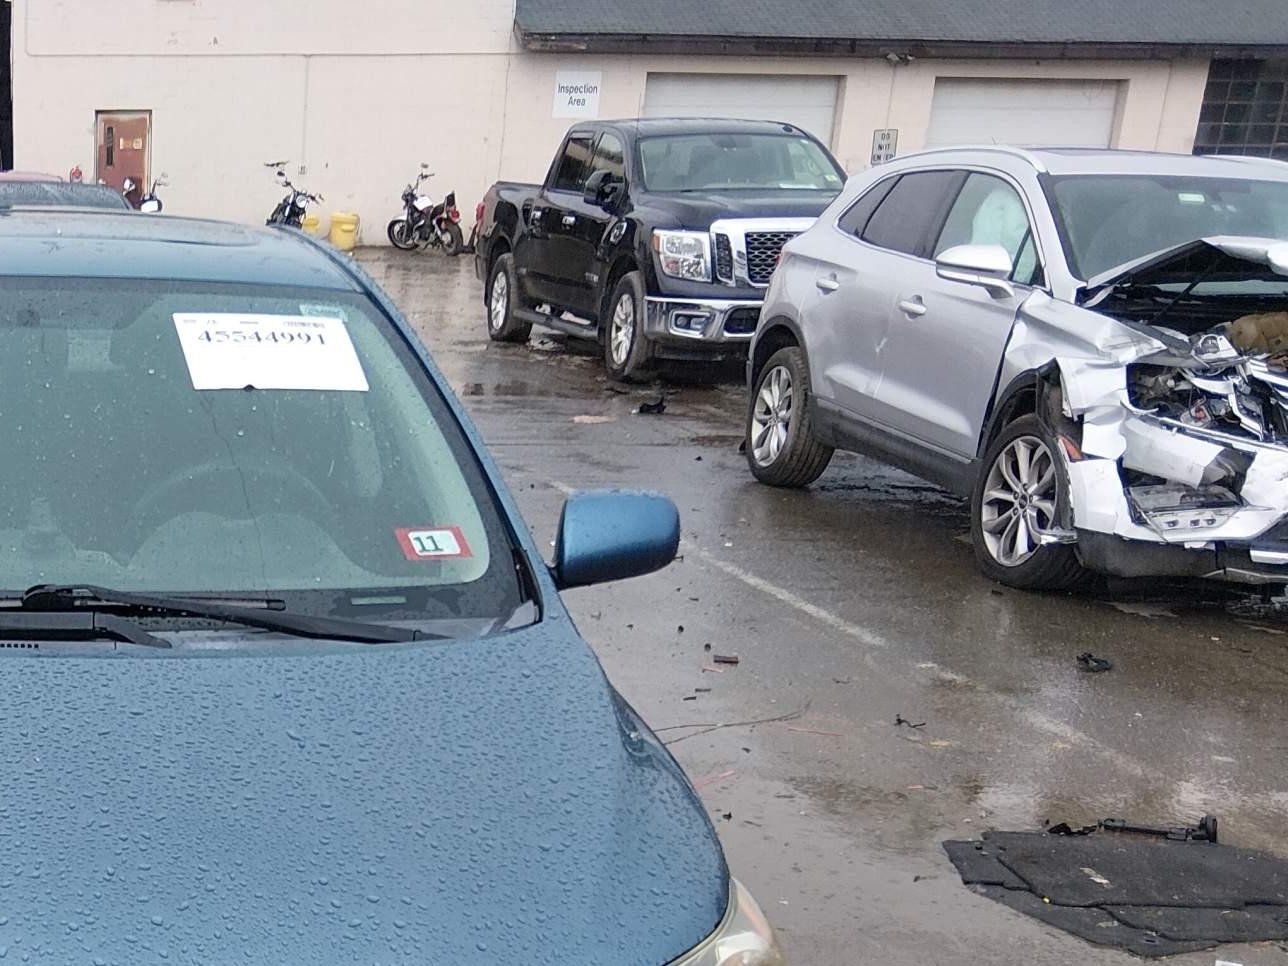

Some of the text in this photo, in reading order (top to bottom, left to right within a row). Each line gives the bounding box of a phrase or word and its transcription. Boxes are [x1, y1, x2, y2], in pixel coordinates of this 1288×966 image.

[558, 83, 598, 95] Inspection
[568, 96, 586, 106] Area
[198, 330, 326, 345] 45544991
[413, 535, 443, 552] 11
